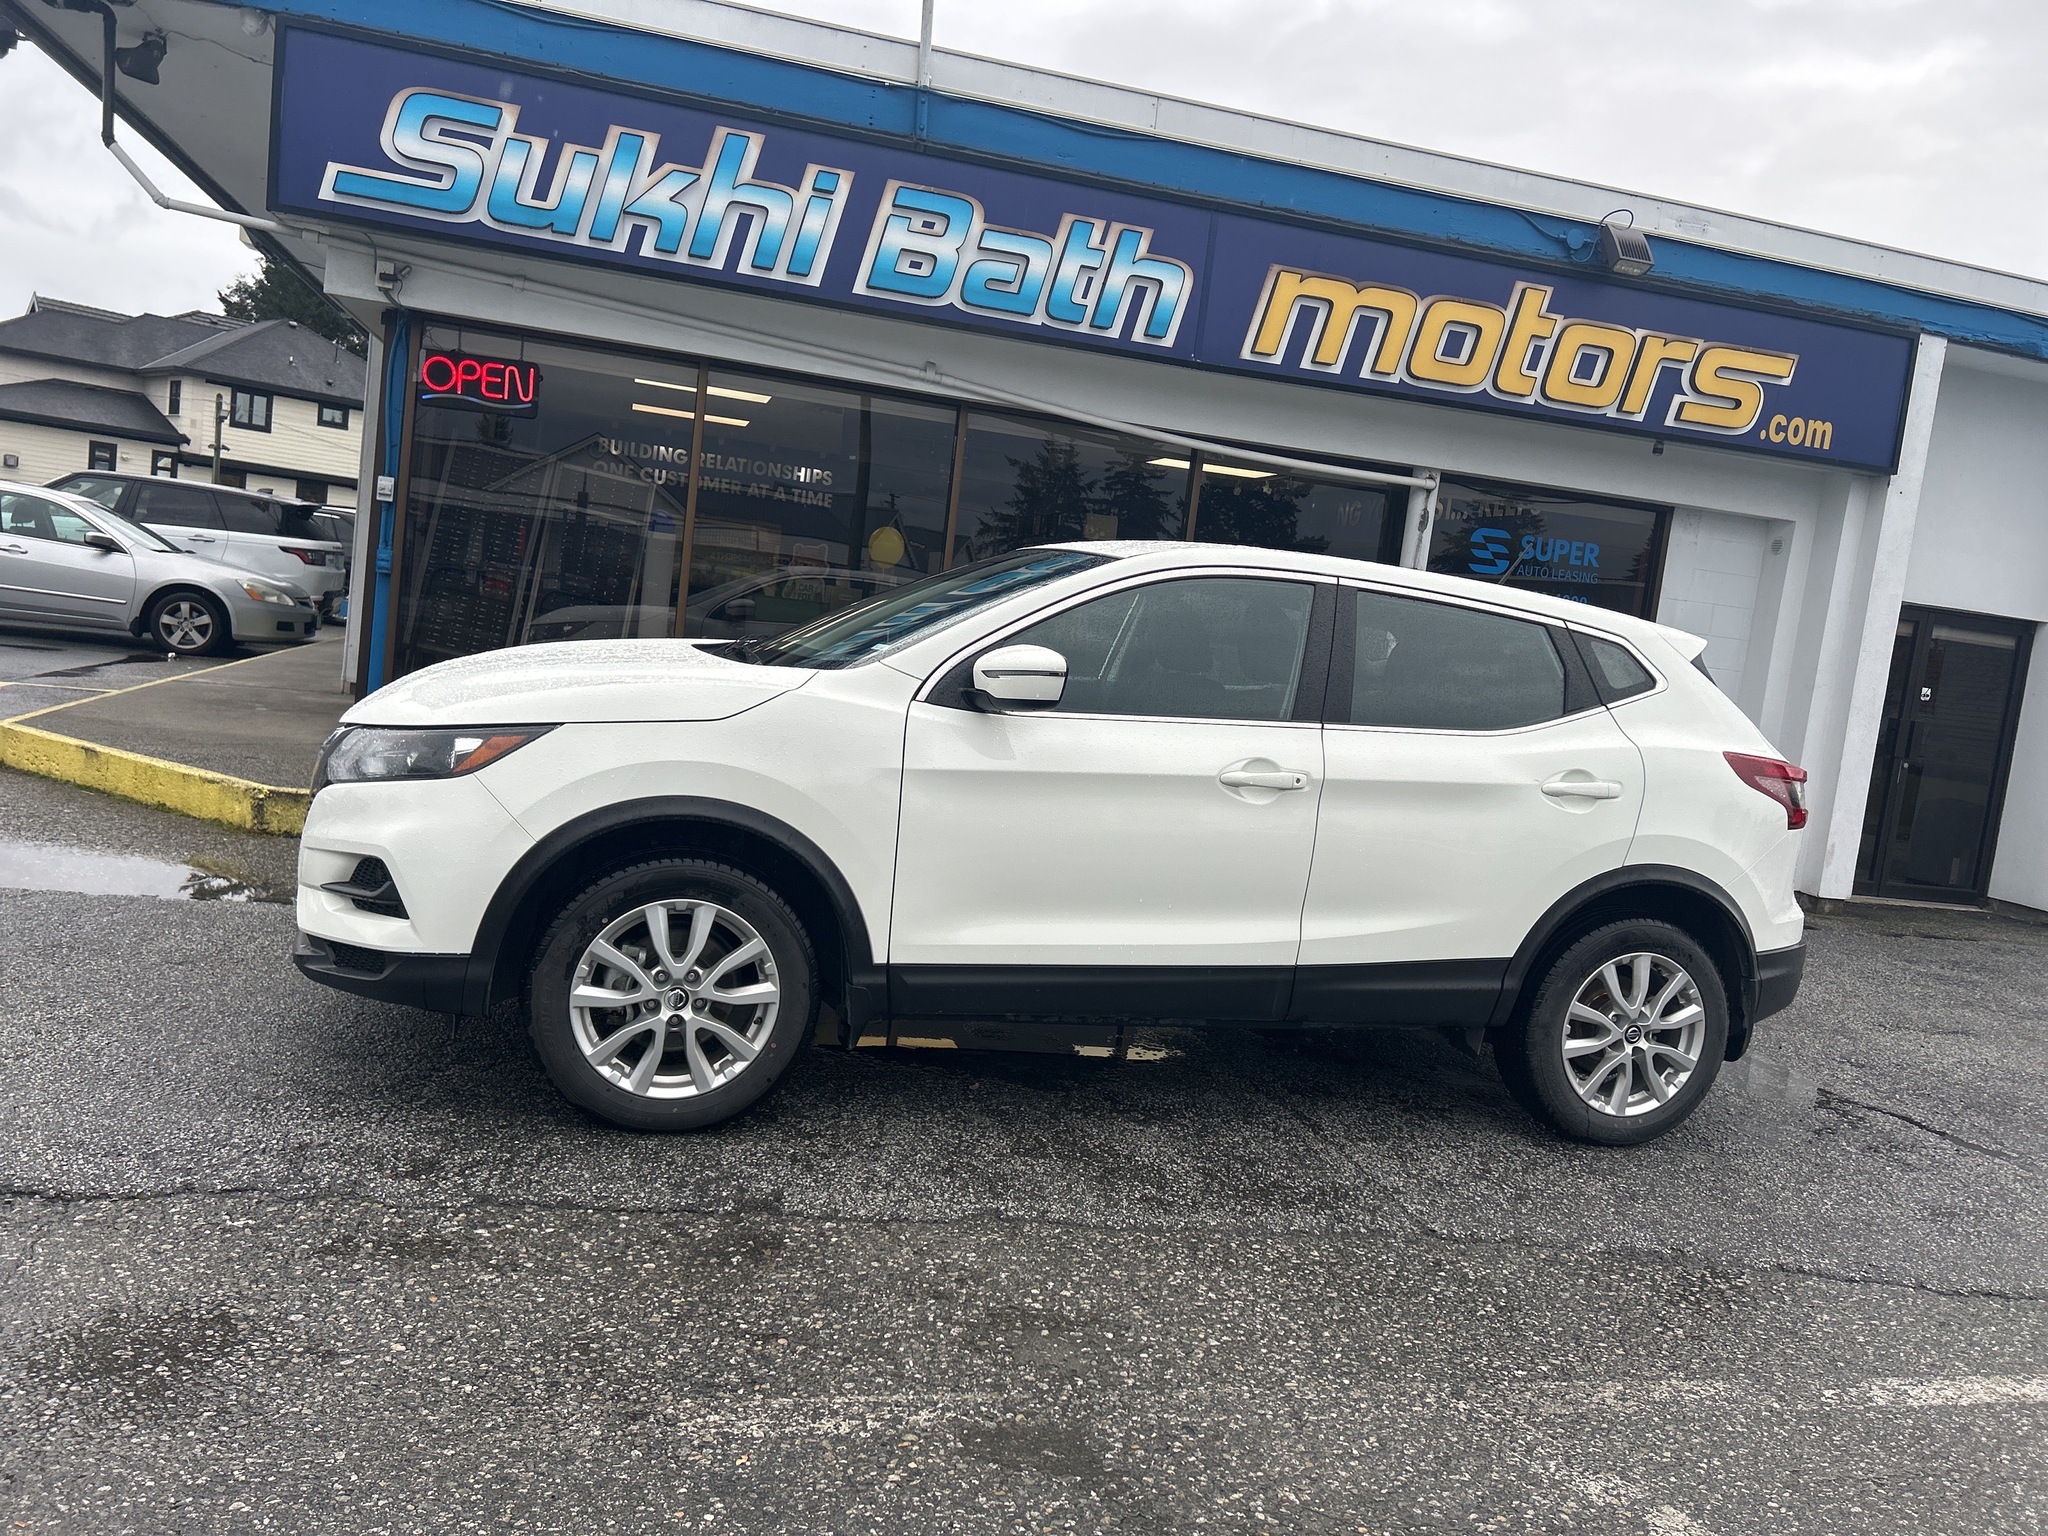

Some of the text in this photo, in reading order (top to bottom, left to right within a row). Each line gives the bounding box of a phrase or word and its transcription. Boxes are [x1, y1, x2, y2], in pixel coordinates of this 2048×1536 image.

[318, 86, 855, 286] Sukhi
[853, 179, 1194, 348] Bath
[1239, 264, 1800, 435] motors
[420, 356, 536, 403] OPEN
[593, 460, 833, 509] ONE CUSTMER AT A TIME
[600, 438, 833, 486] BUILDING RELATIONSHIPS
[1517, 564, 1599, 585] AUTO LEASING
[1518, 534, 1600, 568] SUPER
[799, 583, 814, 592] CAR
